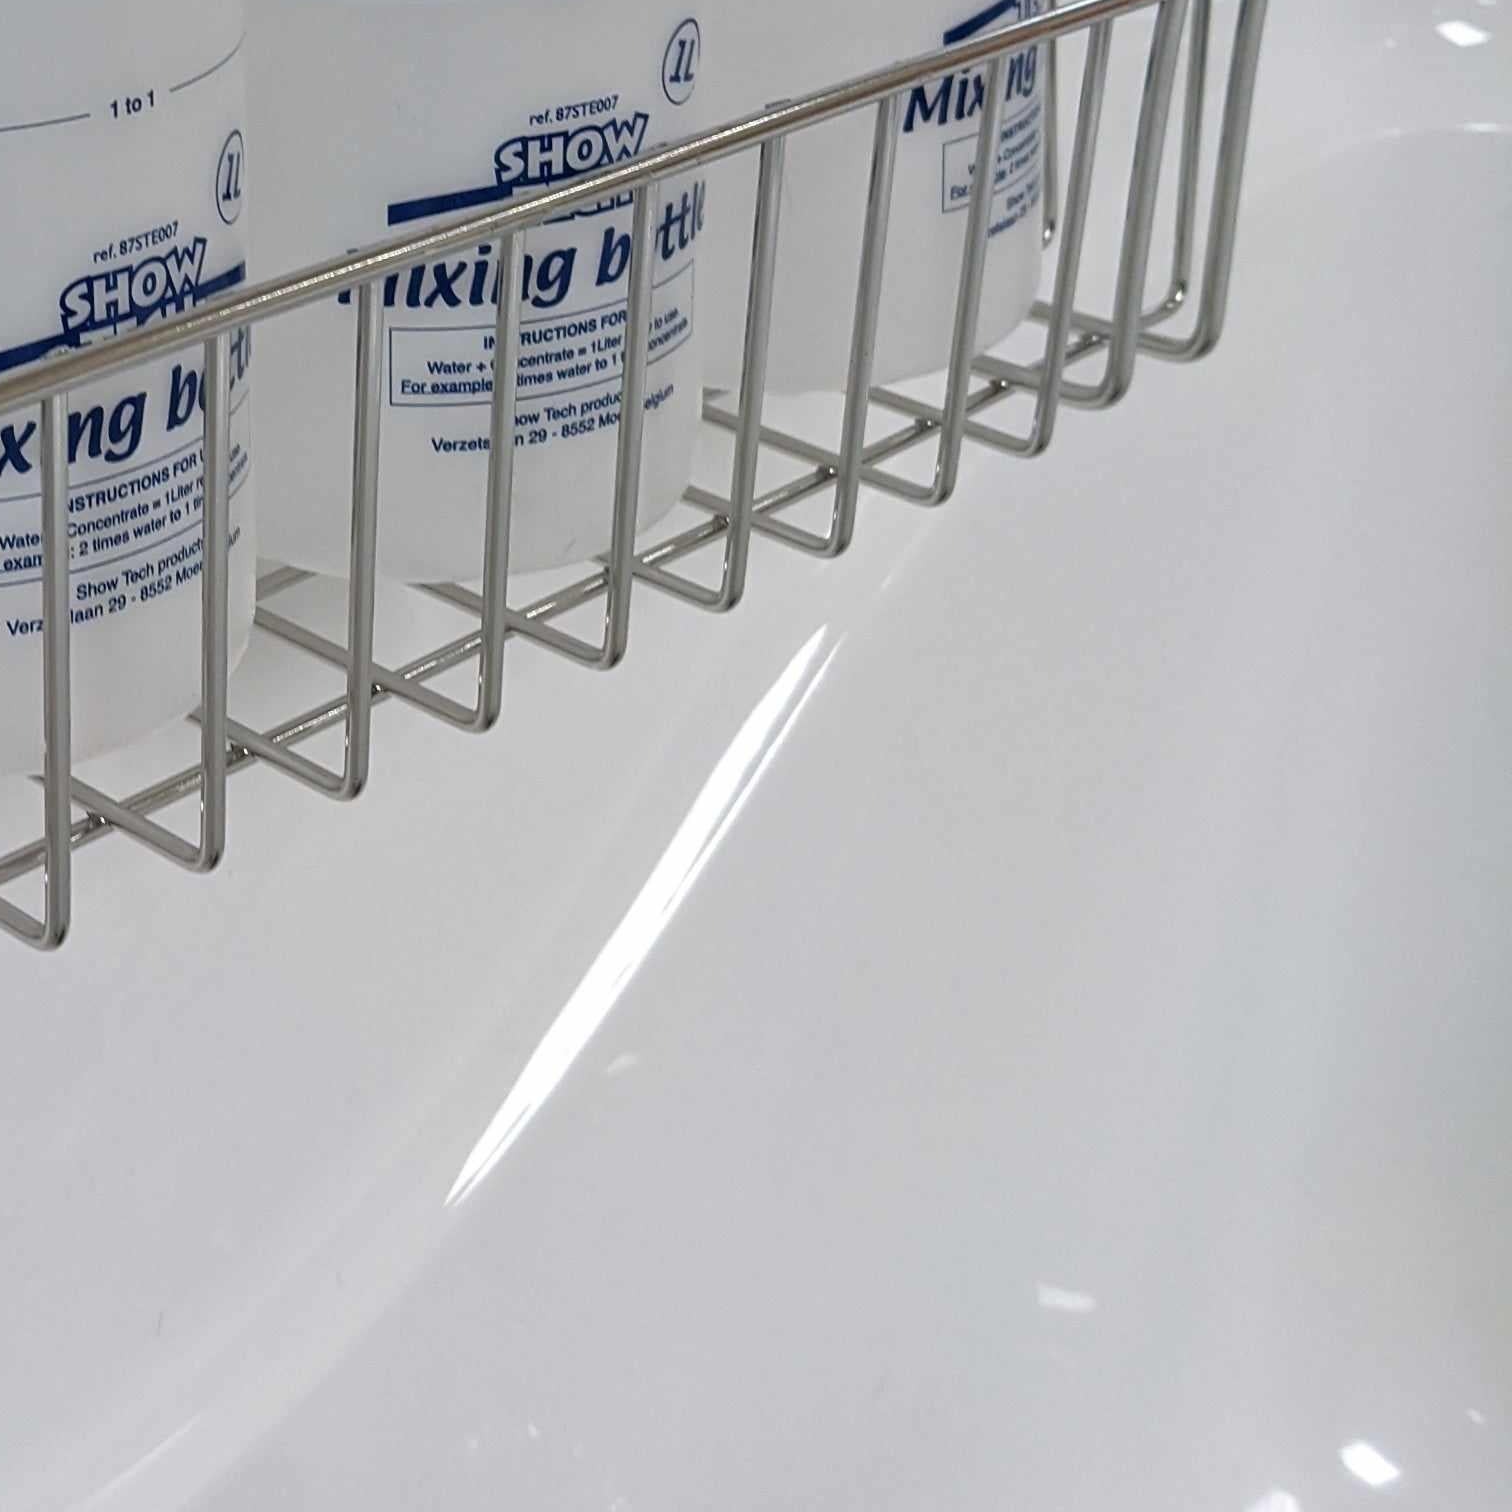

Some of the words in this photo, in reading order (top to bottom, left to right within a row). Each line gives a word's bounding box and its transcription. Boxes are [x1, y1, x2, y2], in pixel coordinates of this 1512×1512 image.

[110, 99, 118, 119] 1
[124, 97, 143, 115] to
[147, 89, 155, 108] 1
[529, 110, 553, 126] ref.
[556, 94, 619, 121] 87STE007
[494, 111, 649, 185] SHOW
[93, 245, 117, 264] ref.
[119, 220, 178, 255] 87STE007
[60, 236, 207, 333] SHOW
